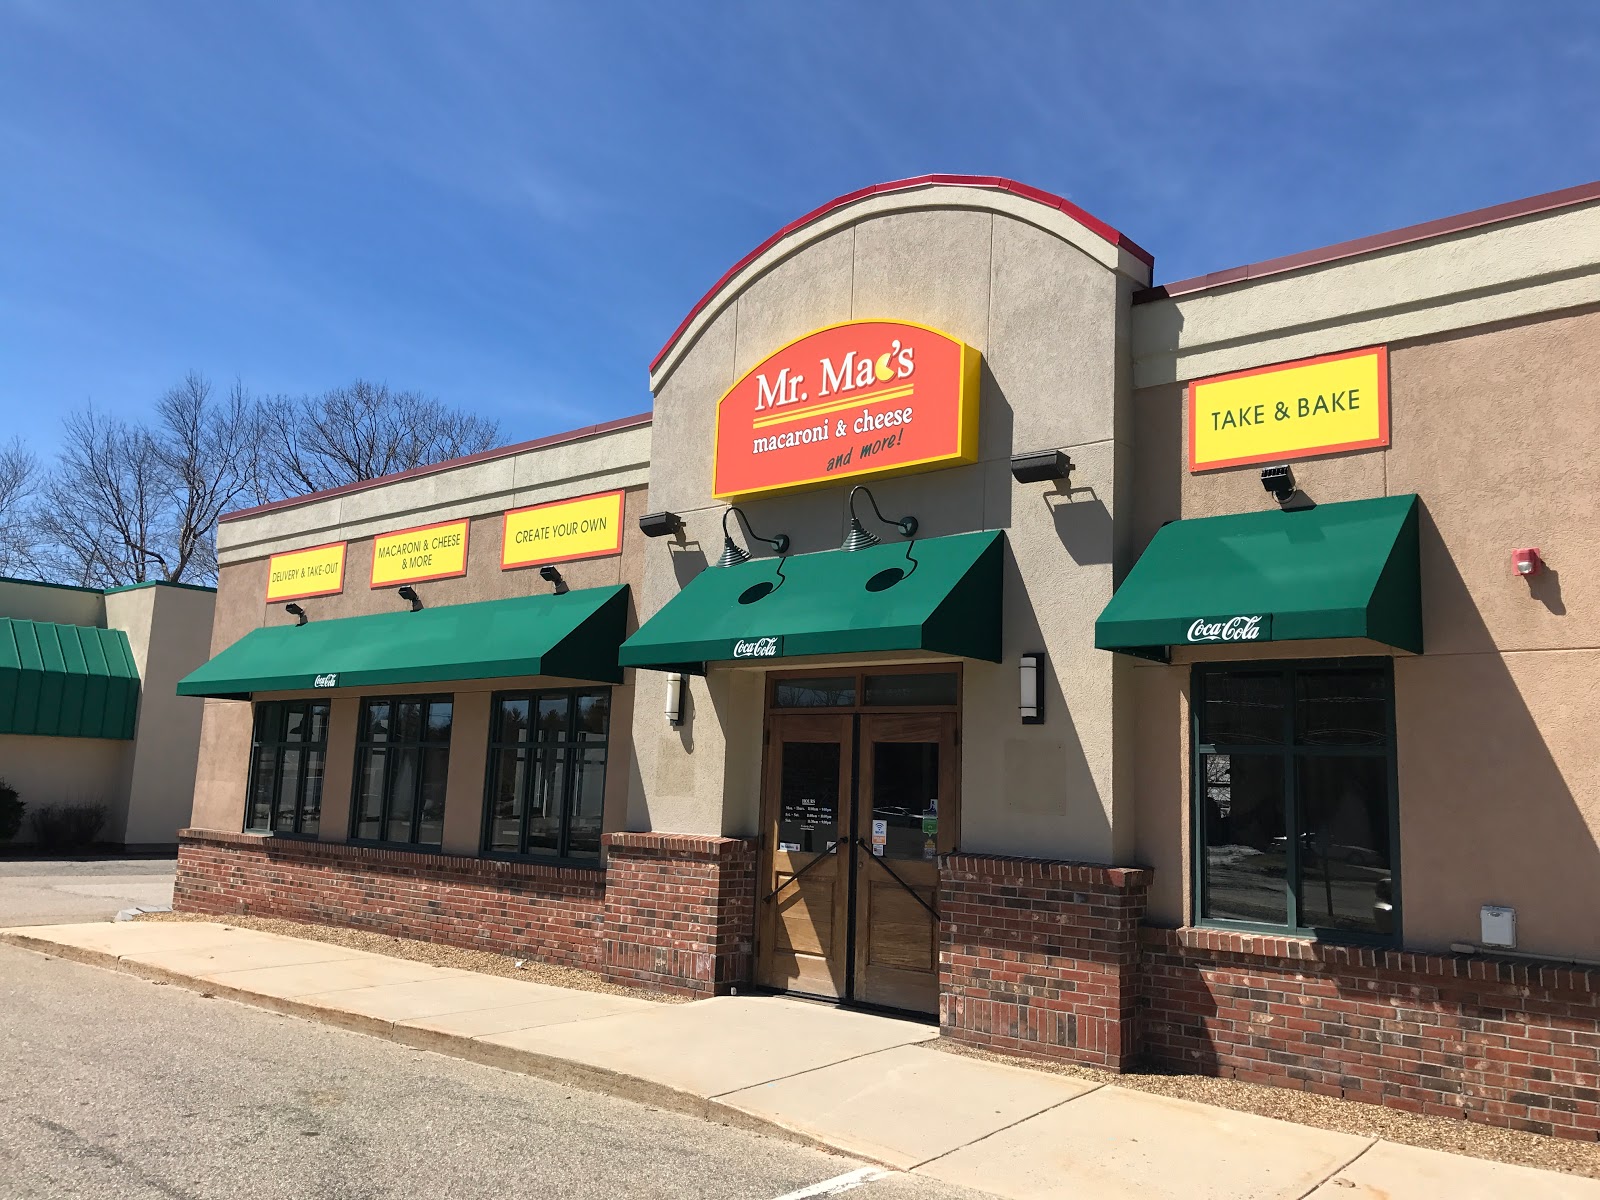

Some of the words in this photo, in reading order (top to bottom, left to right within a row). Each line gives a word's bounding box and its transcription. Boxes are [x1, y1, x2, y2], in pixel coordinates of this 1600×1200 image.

[754, 368, 809, 411] Mr.
[818, 339, 915, 396] Mac's
[1211, 404, 1265, 431] TAKE
[1274, 401, 1291, 421] &
[1297, 389, 1360, 418] BAKE
[752, 419, 829, 454] macaroni
[835, 420, 847, 437] &
[853, 407, 913, 434] cheese
[826, 447, 853, 472] and
[860, 428, 903, 460] more!
[515, 526, 550, 544] CREATE
[552, 521, 578, 538] YOUR
[580, 516, 607, 533] OWN
[378, 540, 421, 558] MACARONI
[423, 539, 429, 551] &
[431, 533, 461, 550] CHEESE
[272, 568, 300, 583] DELIVERY
[300, 567, 306, 578] &
[307, 562, 339, 577] TAKE-OUT
[401, 558, 408, 570] &
[409, 553, 433, 569] MORE
[1186, 616, 1262, 642] Coca-Cola
[733, 637, 778, 658] Coca-Cola
